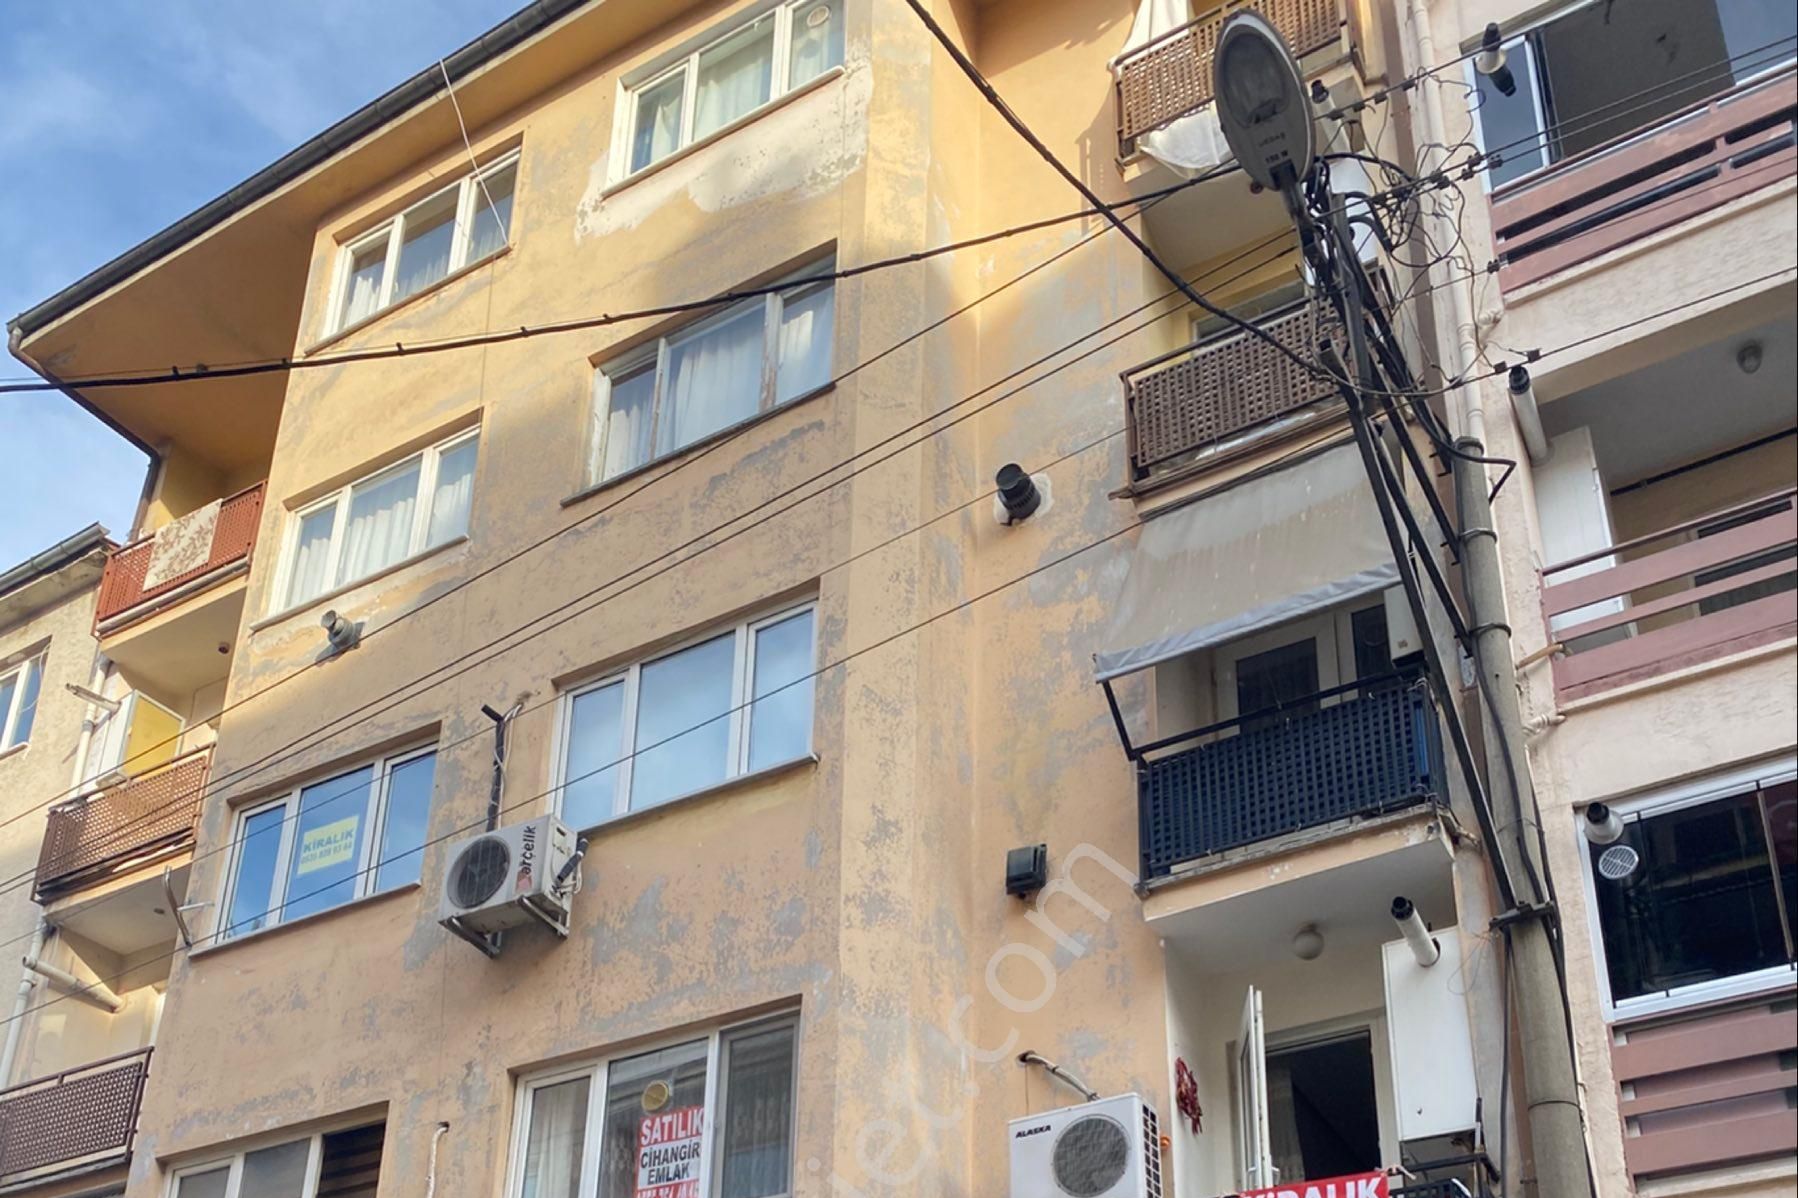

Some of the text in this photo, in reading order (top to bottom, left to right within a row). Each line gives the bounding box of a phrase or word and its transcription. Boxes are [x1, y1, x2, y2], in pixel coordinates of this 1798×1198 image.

[641, 1107, 704, 1146] SATILIK
[1015, 1124, 1051, 1138] ALASKA
[647, 1162, 690, 1185] EMLAK
